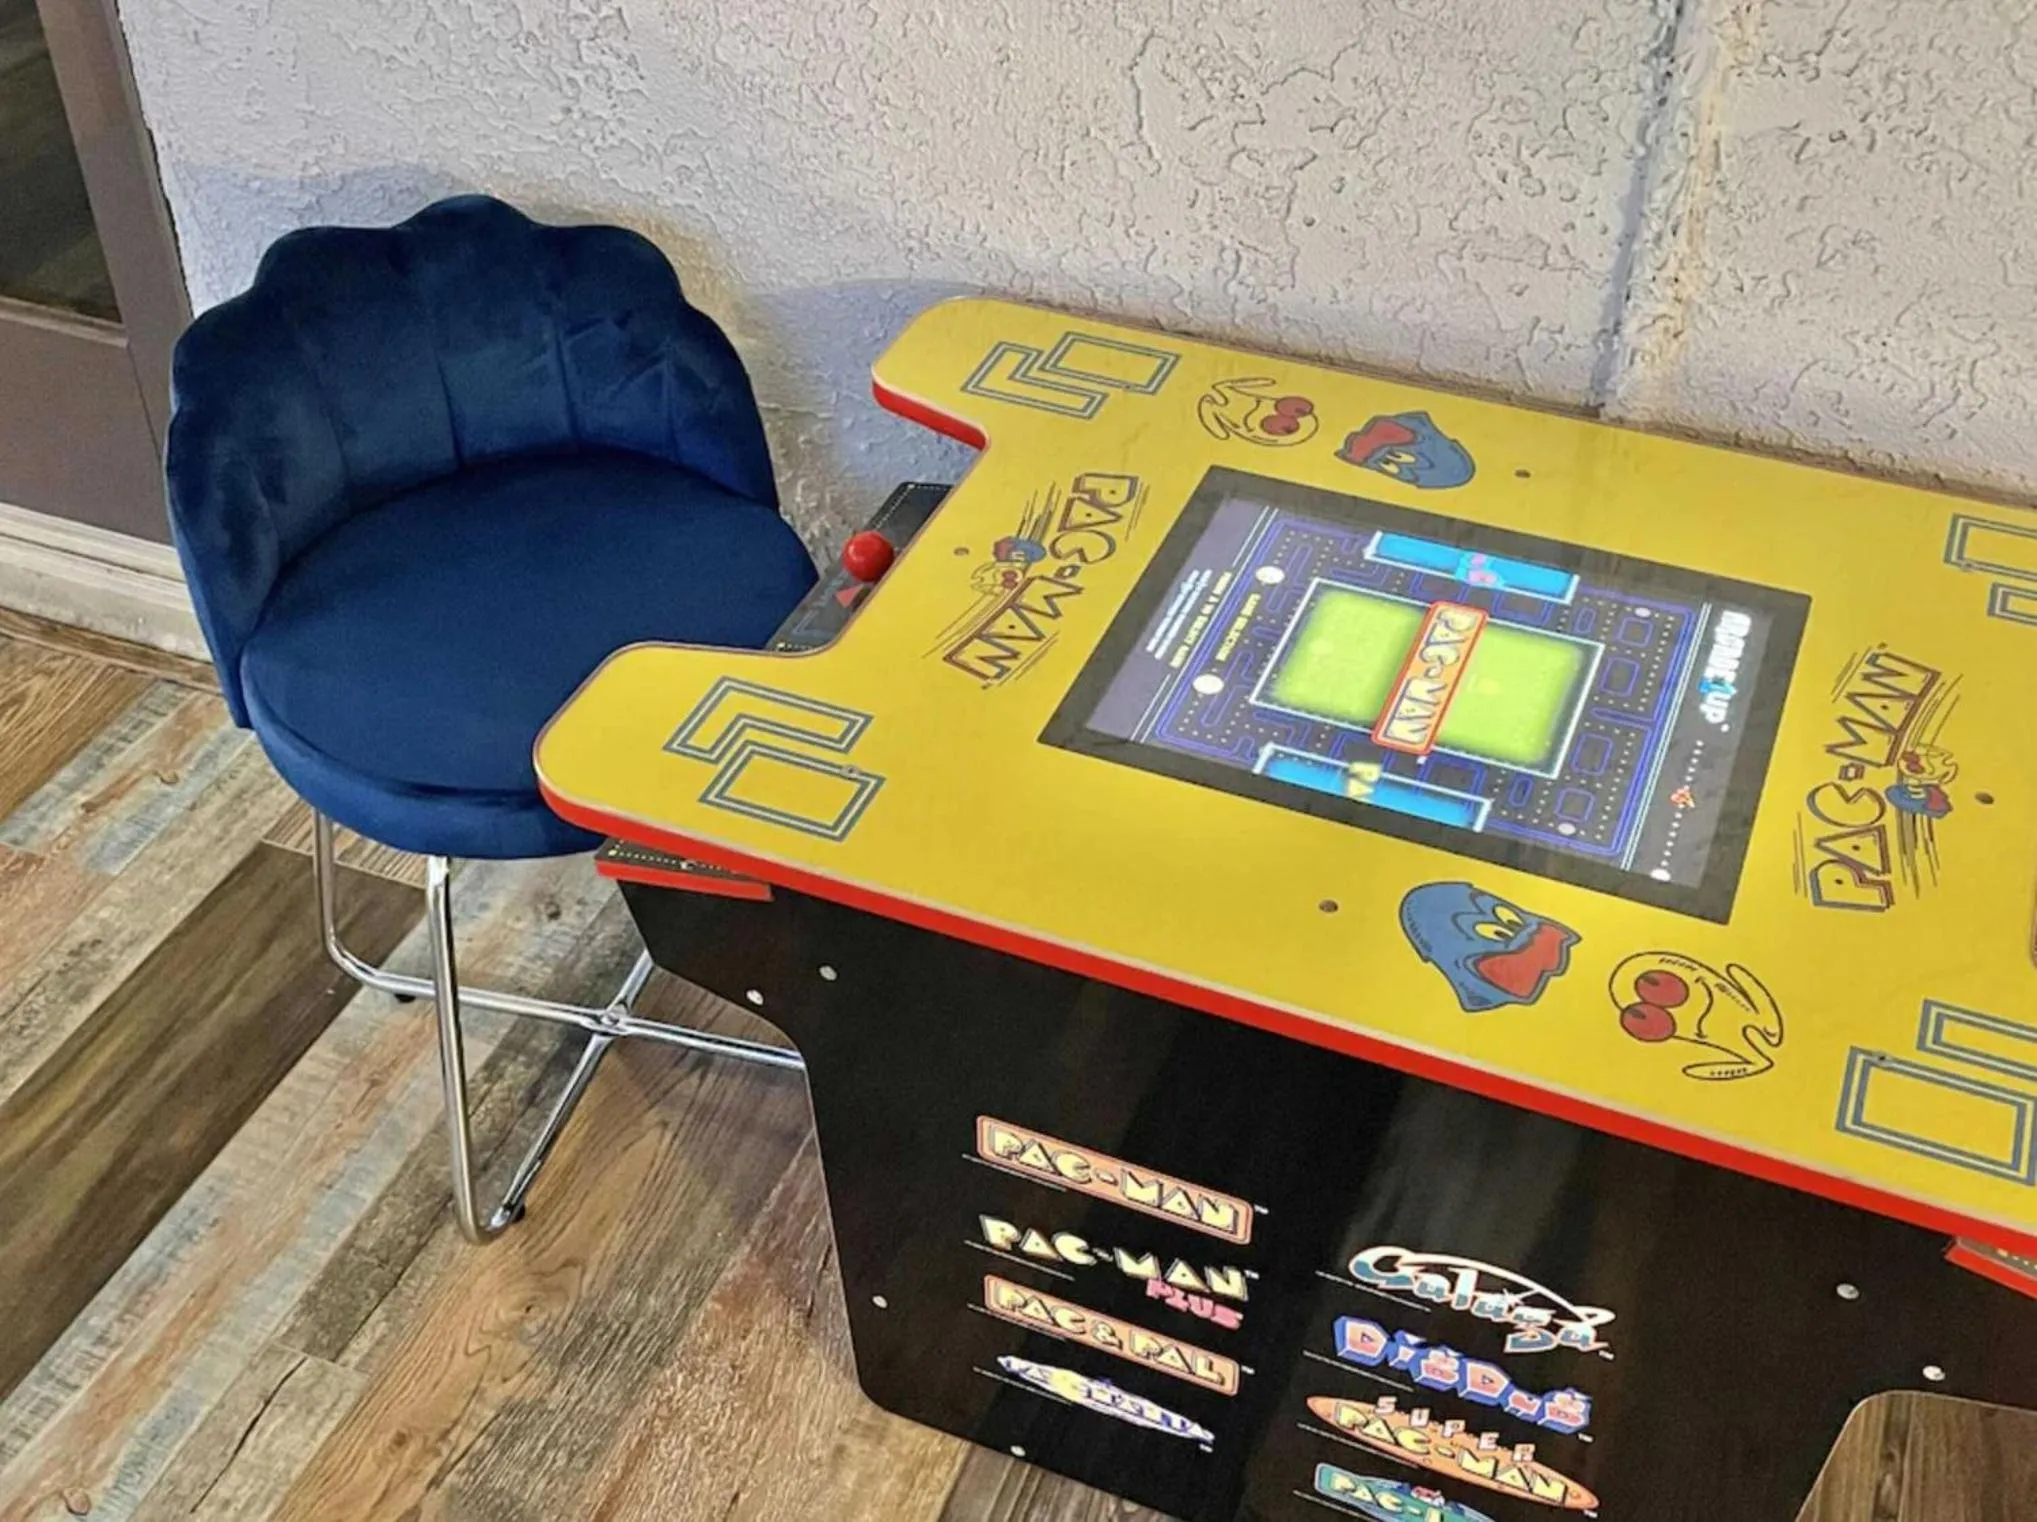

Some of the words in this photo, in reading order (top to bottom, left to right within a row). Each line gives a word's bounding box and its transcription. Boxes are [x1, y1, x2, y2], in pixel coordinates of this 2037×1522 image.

[942, 472, 1140, 681] PAC-MAN
[1382, 607, 1479, 745] PAC-MAN
[1806, 651, 1943, 913] PAC-MAN
[988, 1120, 1240, 1234] PAC-MAN
[978, 1213, 1249, 1302] PAC-MAN
[1334, 1401, 1568, 1503] PAC-MAN
[1374, 1395, 1536, 1462] SUPER
